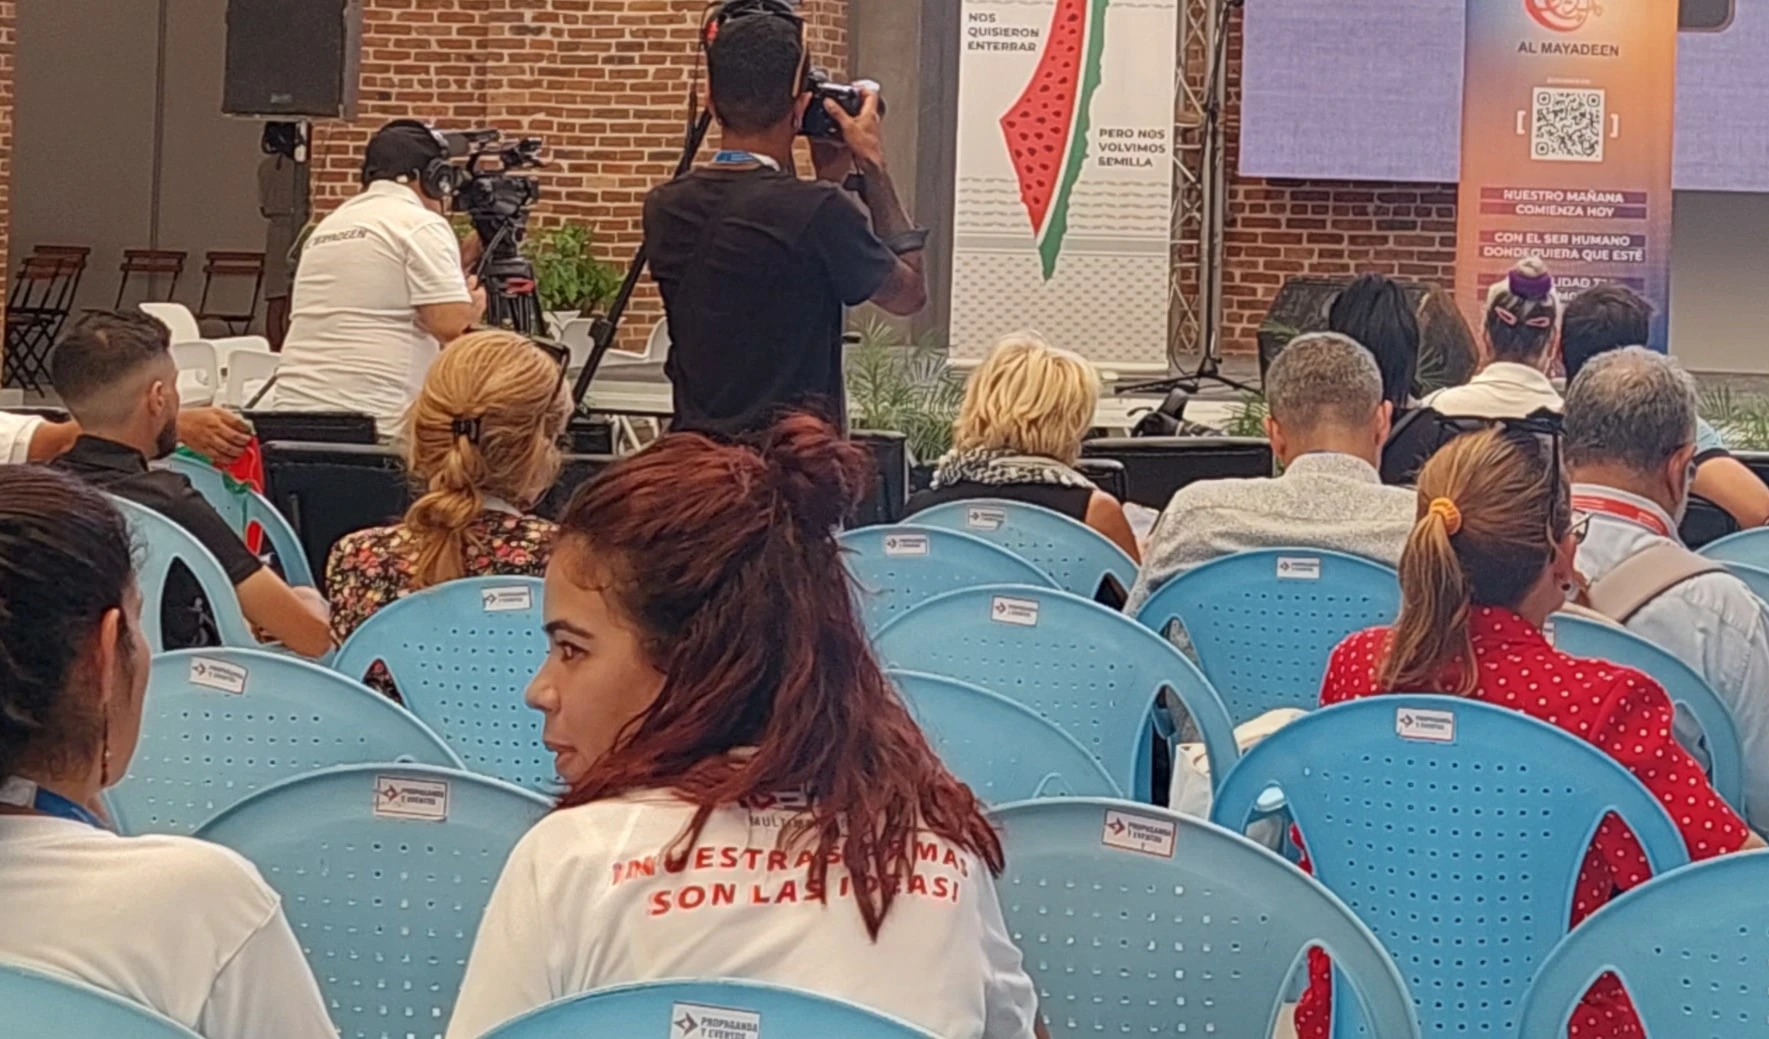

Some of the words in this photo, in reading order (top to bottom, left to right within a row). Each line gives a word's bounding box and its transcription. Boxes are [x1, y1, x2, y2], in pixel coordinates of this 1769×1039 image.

[968, 12, 997, 23] NOS
[967, 26, 1040, 38] QUISIERON
[967, 40, 1037, 52] ENTERRAR
[1517, 40, 1538, 55] AL
[1540, 42, 1620, 57] MAYADEEN
[1099, 127, 1134, 139] PERO
[1137, 128, 1166, 140] NOS
[1098, 142, 1166, 154] VOLVIMOS
[1097, 156, 1154, 168] SEMILLA
[1503, 189, 1564, 202] NUESTRO
[1566, 188, 1624, 204] MAÑANA
[1515, 204, 1584, 217] COMIENZA
[1586, 206, 1615, 218] HOY
[1494, 232, 1523, 244] CON
[1525, 232, 1541, 244] EL
[1543, 233, 1569, 245] SER
[1571, 234, 1630, 247] HUMANO
[1581, 249, 1609, 262] QUE
[1612, 247, 1644, 262] ESTÉ
[650, 882, 737, 916] SON
[752, 878, 825, 904] LAS
[700, 1016, 758, 1032] PROPAGANDA
